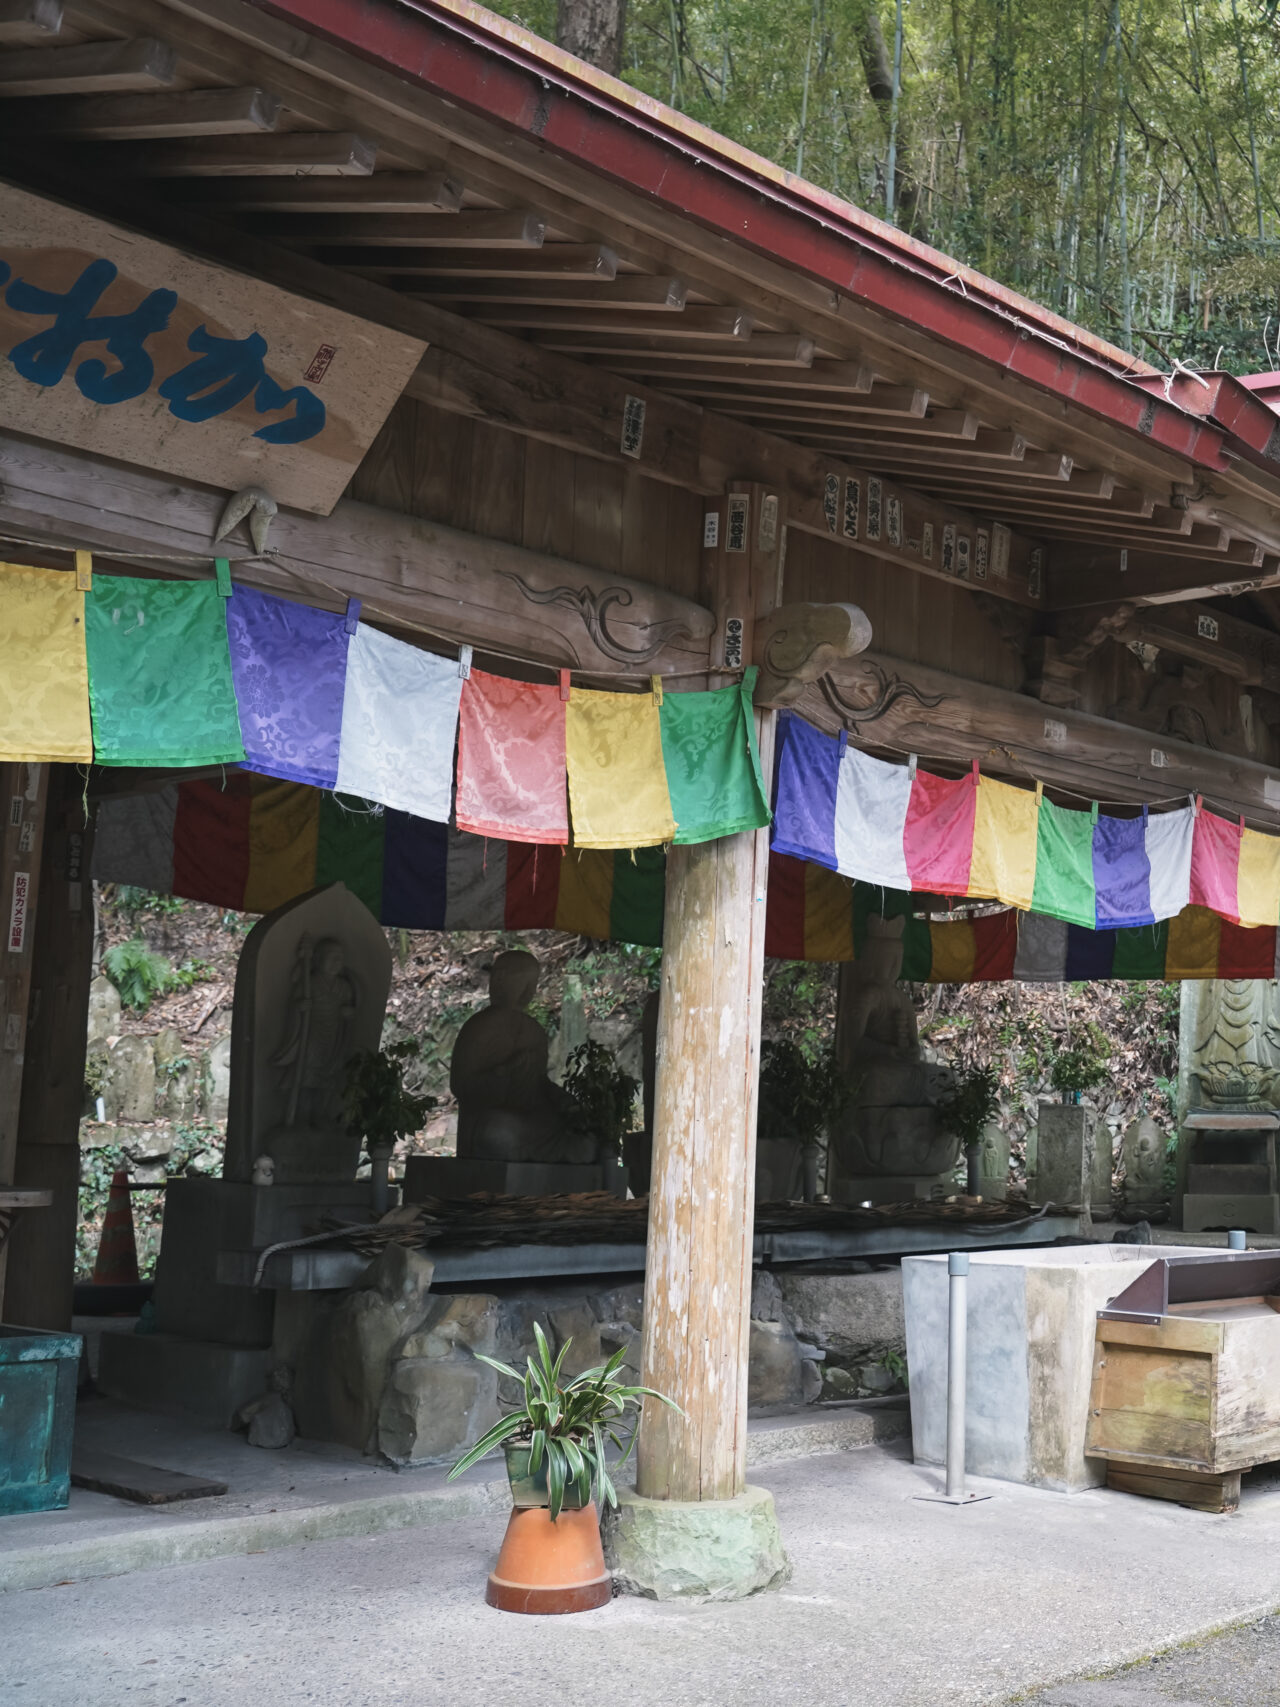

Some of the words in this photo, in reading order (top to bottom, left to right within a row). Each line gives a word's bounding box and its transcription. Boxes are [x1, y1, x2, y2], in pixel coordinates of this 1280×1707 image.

[11, 876, 27, 947] 防犯カメラ設置
